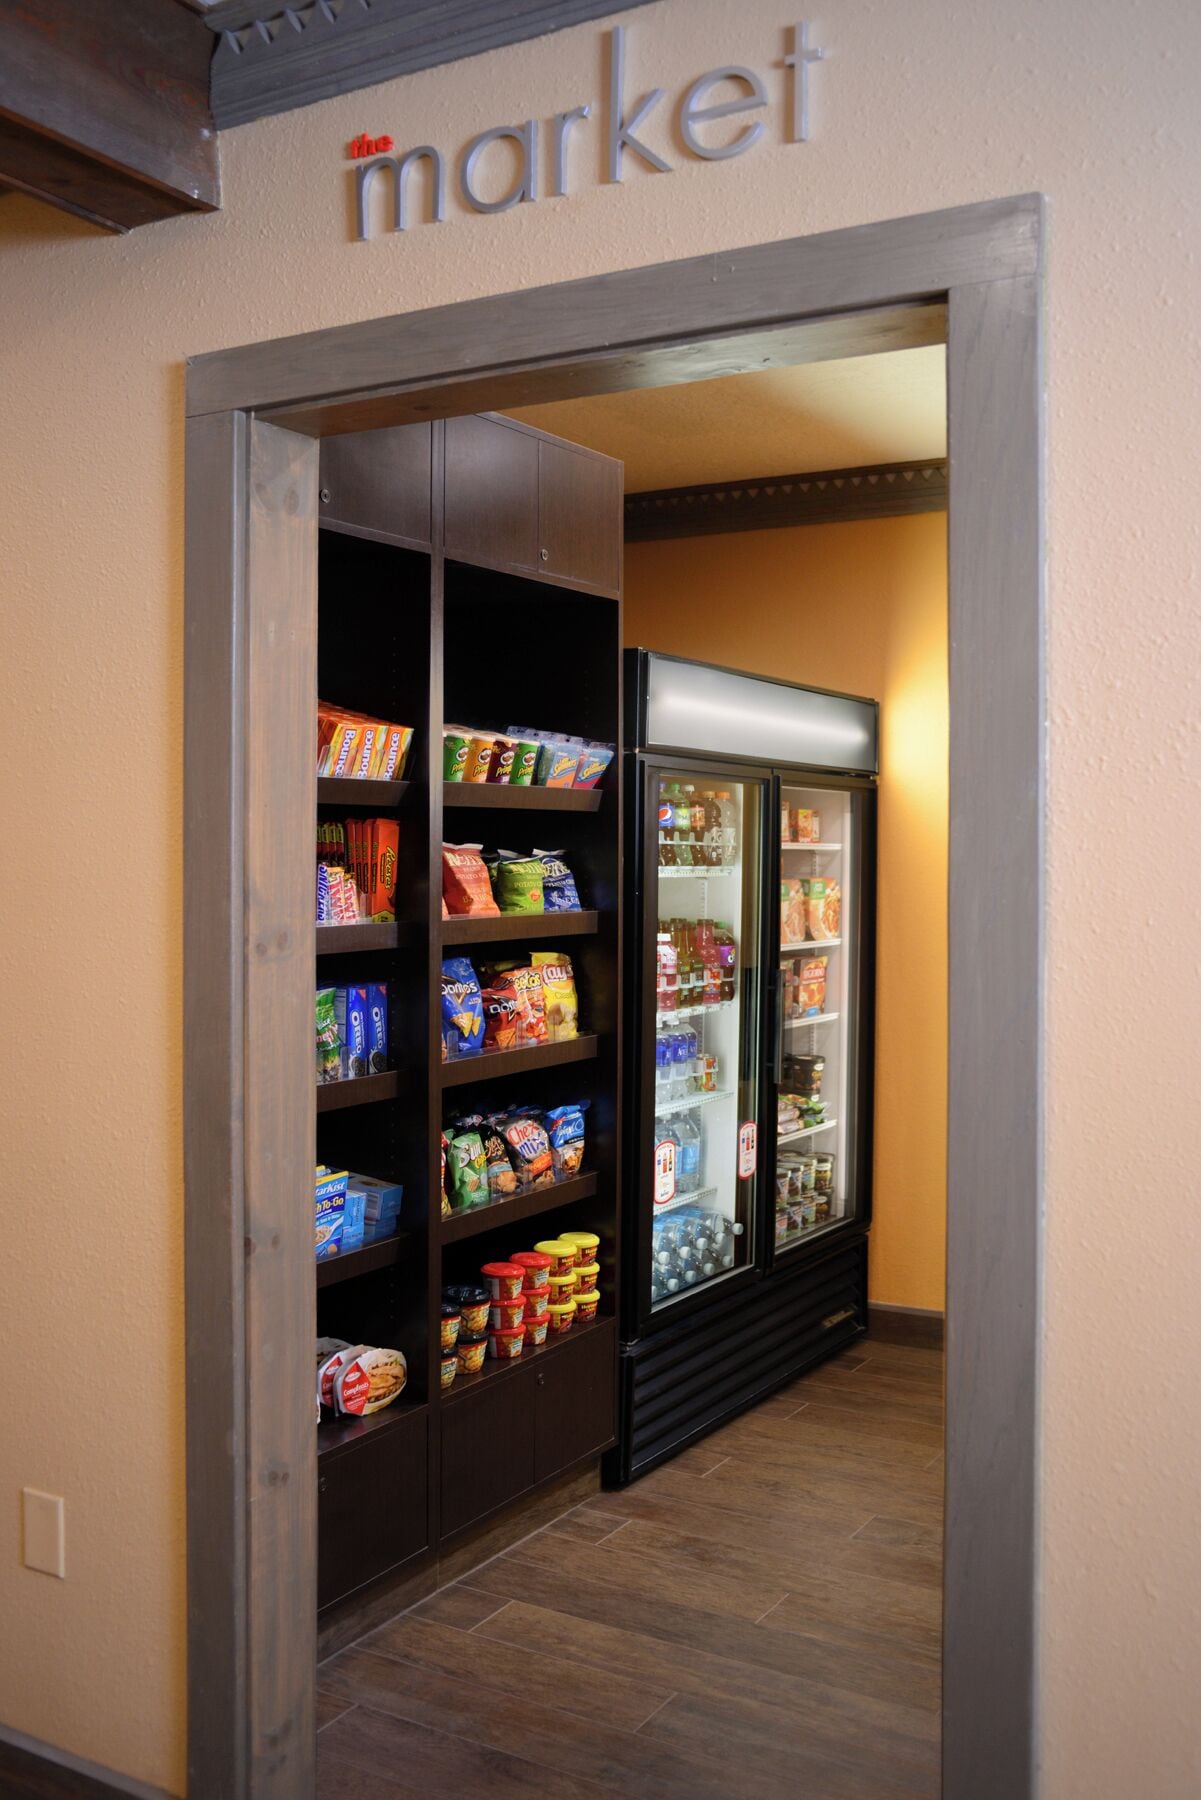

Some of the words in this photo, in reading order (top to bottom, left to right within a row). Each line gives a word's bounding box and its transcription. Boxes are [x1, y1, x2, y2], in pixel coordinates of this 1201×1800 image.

[349, 132, 394, 159] the
[354, 21, 825, 241] market
[351, 1011, 363, 1054] OREO
[371, 1006, 384, 1049] OREO
[506, 1121, 541, 1146] Chex
